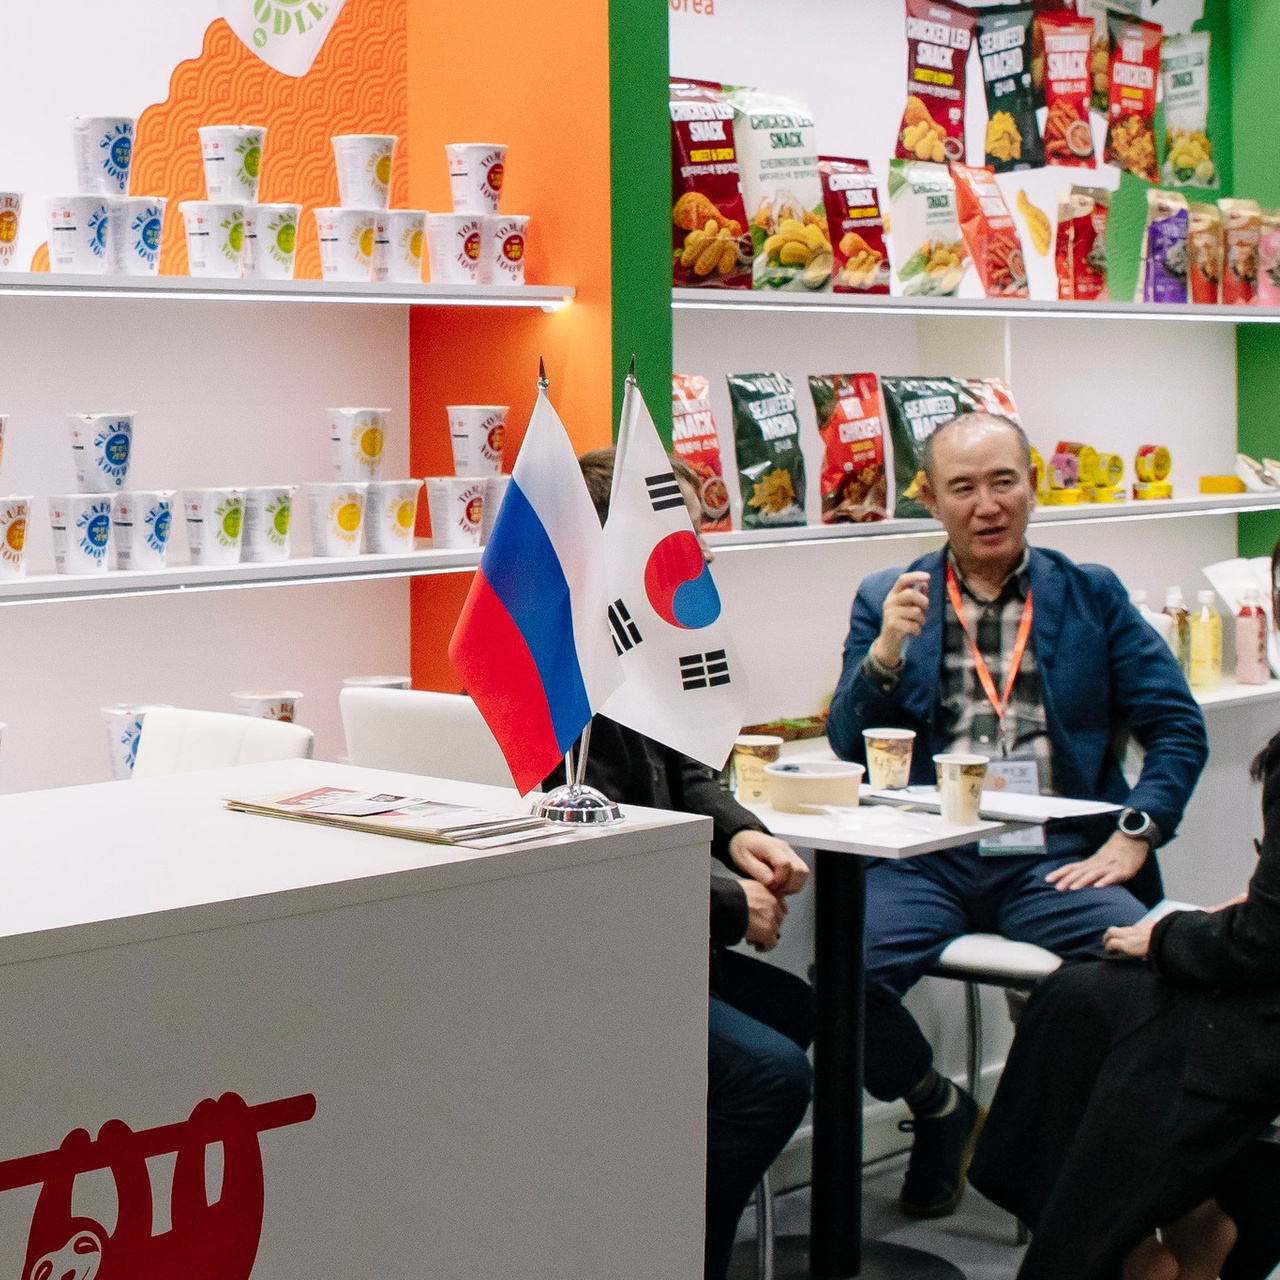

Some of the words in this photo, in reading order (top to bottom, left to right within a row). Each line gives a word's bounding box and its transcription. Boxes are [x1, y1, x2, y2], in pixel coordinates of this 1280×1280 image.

[906, 17, 951, 45] CHICKEN
[917, 42, 954, 70] SNACK
[983, 47, 1024, 82] NACHO
[1047, 52, 1088, 81] SNACK
[688, 120, 727, 142] SNACK
[770, 132, 804, 149] SNACK
